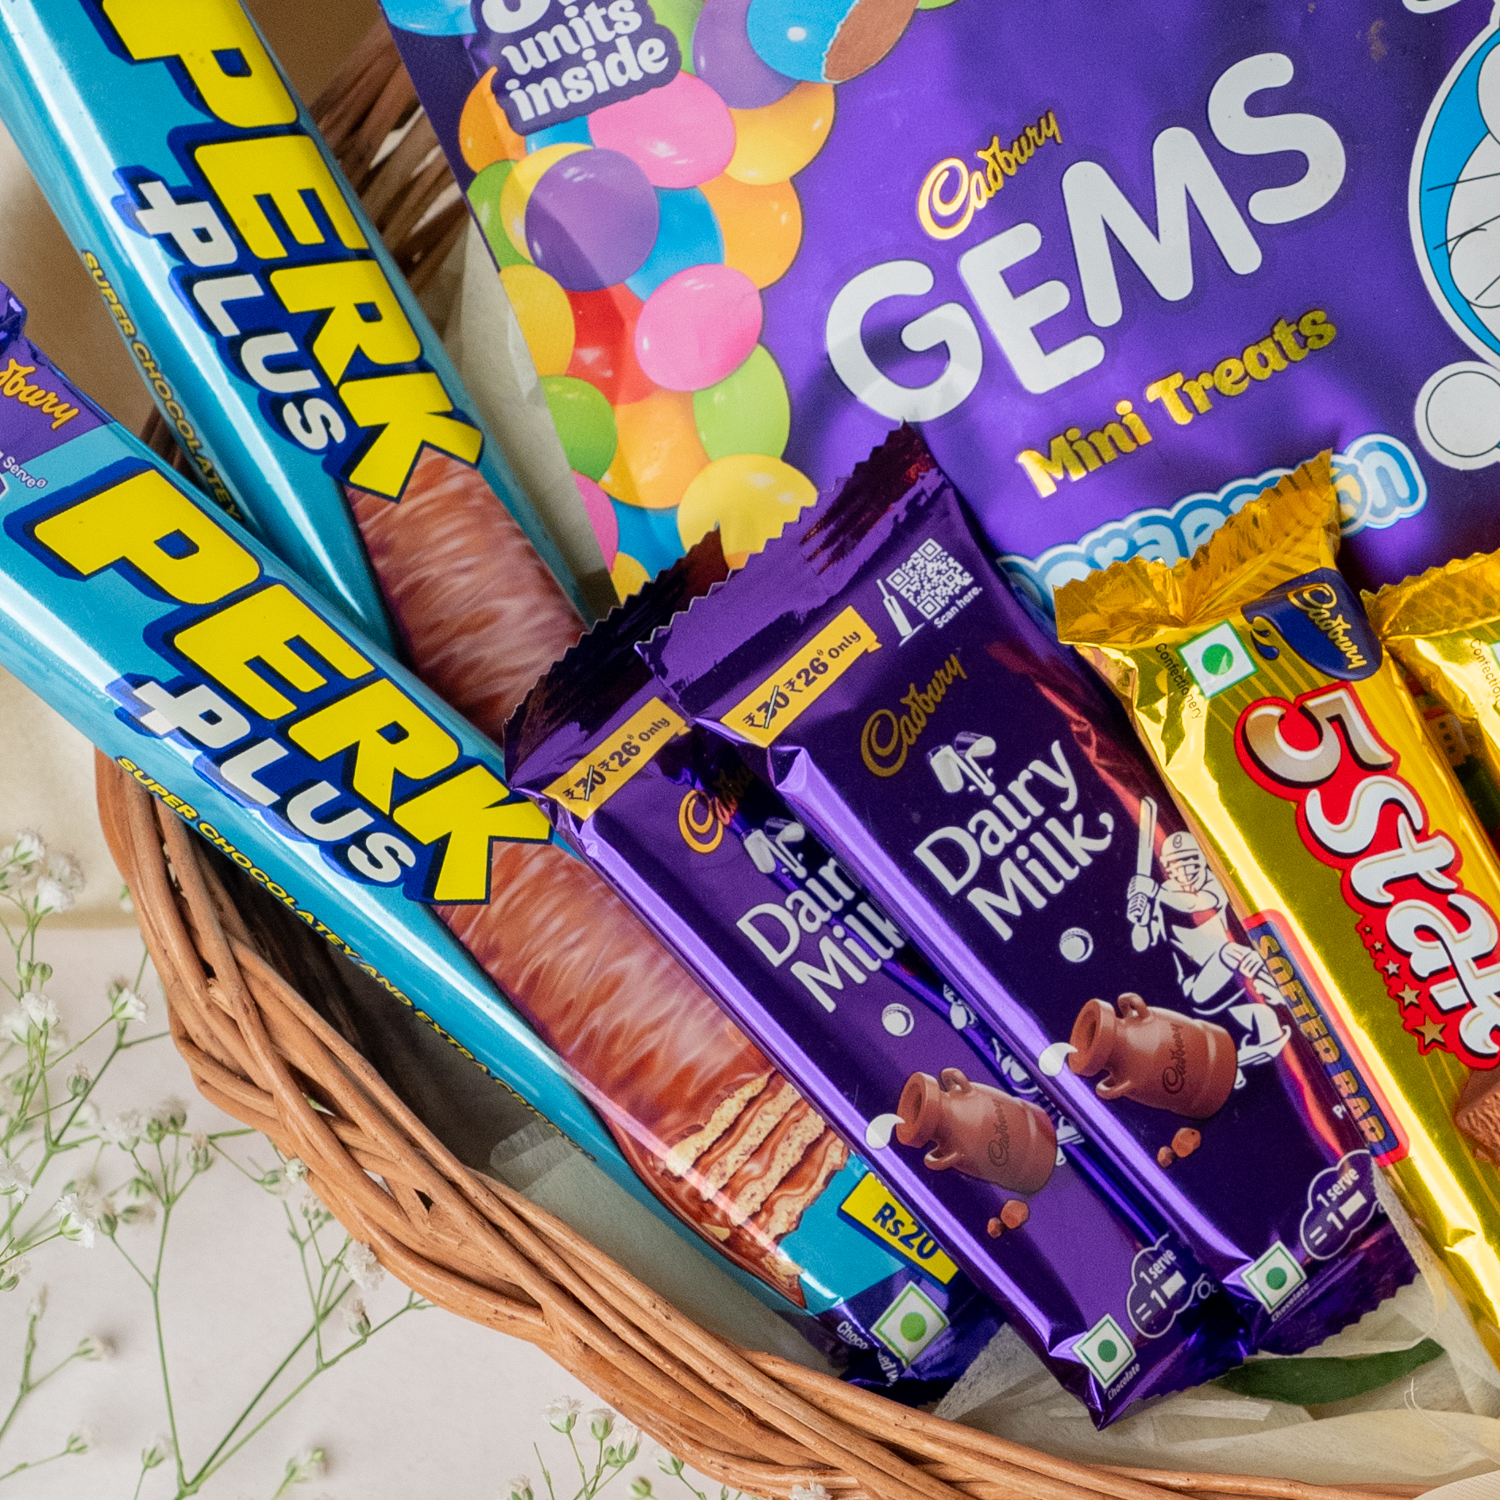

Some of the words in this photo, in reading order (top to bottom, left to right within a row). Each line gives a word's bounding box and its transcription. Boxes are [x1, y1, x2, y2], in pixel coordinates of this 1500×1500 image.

[501, 0, 642, 76] units
[504, 35, 670, 122] inside
[917, 110, 1063, 240] Cadbury
[102, 0, 484, 501] PERK
[825, 52, 1347, 423] GEMS
[81, 249, 137, 338] SUPER
[132, 341, 246, 524] CHOCOLATEY
[1016, 400, 1153, 499] Mini
[1146, 309, 1338, 426] Treats
[828, 630, 862, 660] Only
[933, 604, 959, 630] Scan
[1287, 581, 1368, 671] Cadbury
[34, 470, 552, 902] PERK
[860, 654, 969, 778] Cadbury
[1155, 642, 1204, 720] Confectionery
[638, 717, 671, 742] Only
[913, 740, 1079, 896] Dairy
[116, 755, 198, 821] SUPER
[198, 821, 362, 958] CHOCOLATEY
[360, 962, 414, 1008] AND
[735, 856, 857, 968] Dair
[967, 811, 1115, 942] Milk
[1162, 1022, 1186, 1095] Cadbury
[1325, 1166, 1360, 1202] serve
[1148, 1249, 1178, 1279] serve
[1270, 1283, 1310, 1323] Chocolate
[837, 1320, 869, 1350] Choco
[1107, 1362, 1141, 1401] Chocolate
